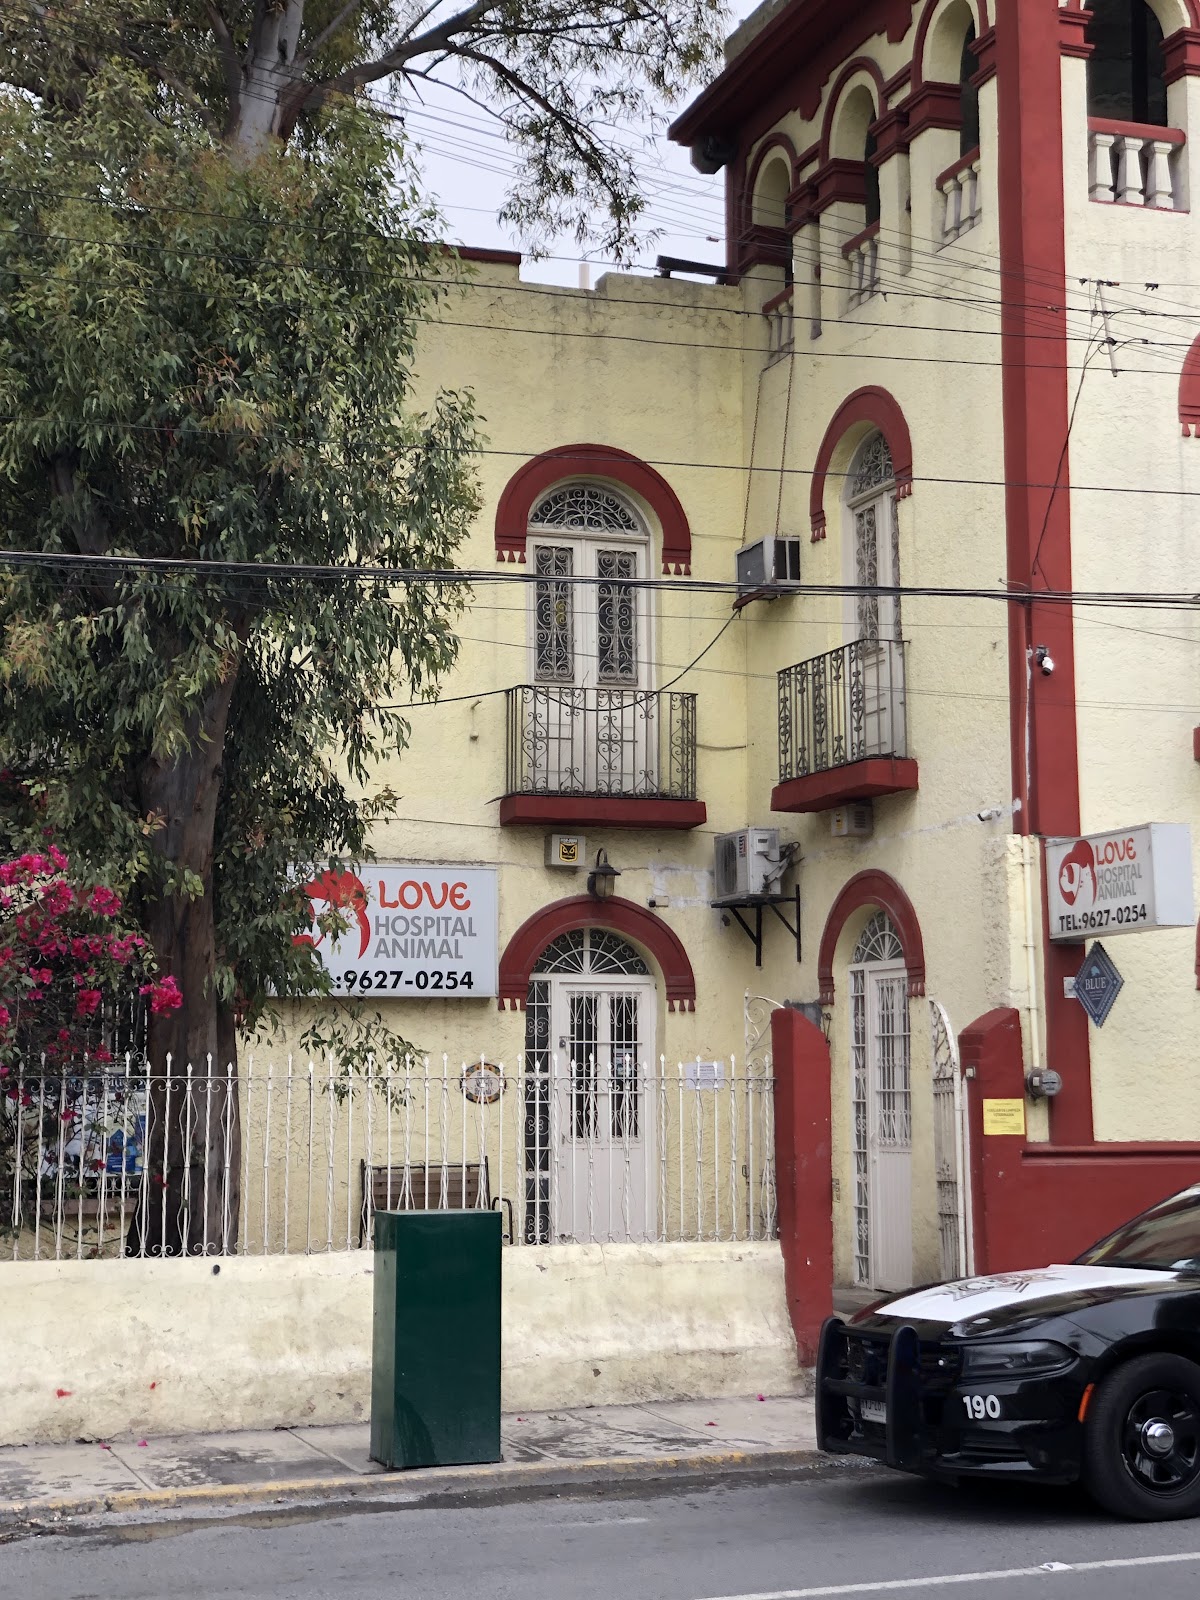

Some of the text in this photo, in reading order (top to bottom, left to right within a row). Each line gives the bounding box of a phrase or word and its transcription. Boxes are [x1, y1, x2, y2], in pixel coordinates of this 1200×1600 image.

[1096, 837, 1137, 866] LOVE
[1097, 862, 1142, 886] HOSPITAL
[378, 880, 471, 911] LOVE
[1098, 880, 1137, 901] ANIMAL
[374, 915, 477, 937] HOSPITAL
[1059, 903, 1147, 932] TEL:9627-0254
[373, 938, 464, 959] ANIMAL
[1085, 976, 1107, 990] BLUE
[962, 1394, 1001, 1419] 190
